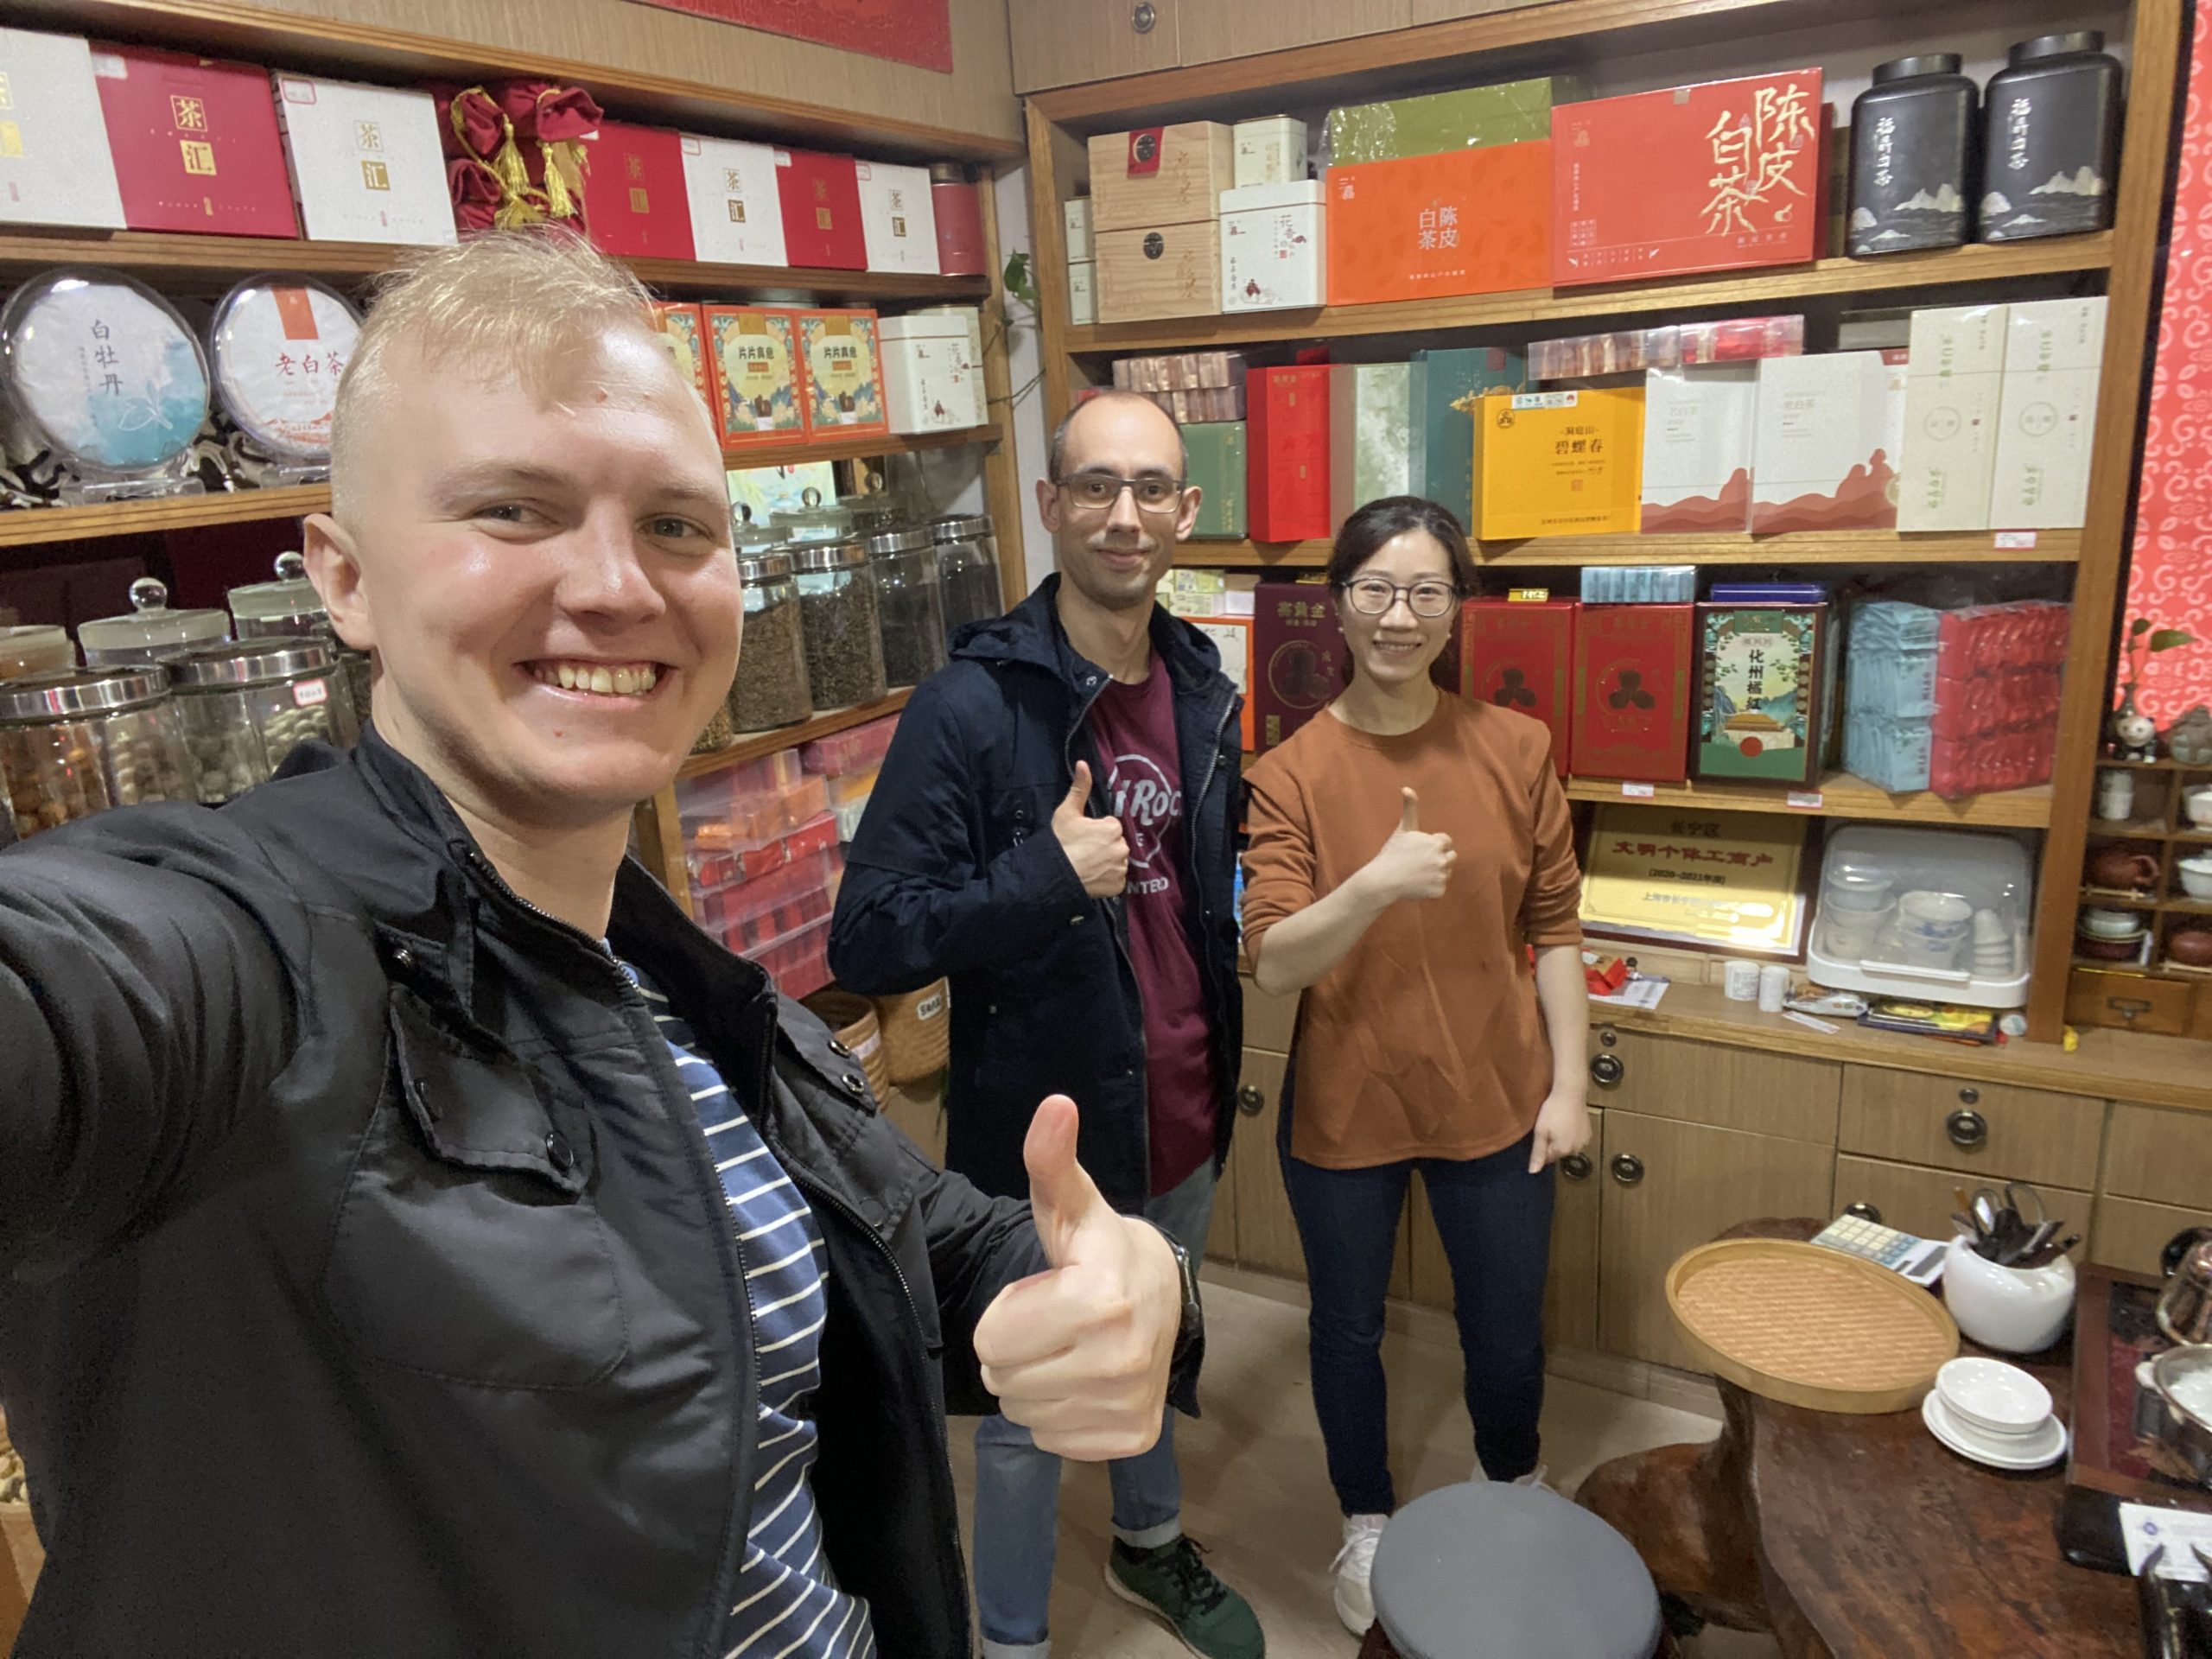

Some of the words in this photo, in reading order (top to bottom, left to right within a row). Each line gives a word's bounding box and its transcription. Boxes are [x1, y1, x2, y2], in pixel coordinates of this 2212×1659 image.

[175, 99, 213, 172] 茶汇
[359, 123, 388, 189] 茶汇
[1755, 84, 1815, 195] 陈皮
[727, 170, 745, 221] 茶汇
[1700, 111, 1769, 237] 白茶
[1418, 208, 1438, 251] 白茶
[1439, 207, 1458, 249] 陈皮
[91, 319, 124, 396] 白牡丹
[275, 351, 345, 378] 老白茶
[1554, 439, 1604, 455] 碧螺春
[1130, 779, 1182, 826] Roc
[1611, 841, 1775, 868] 文明个体工商户
